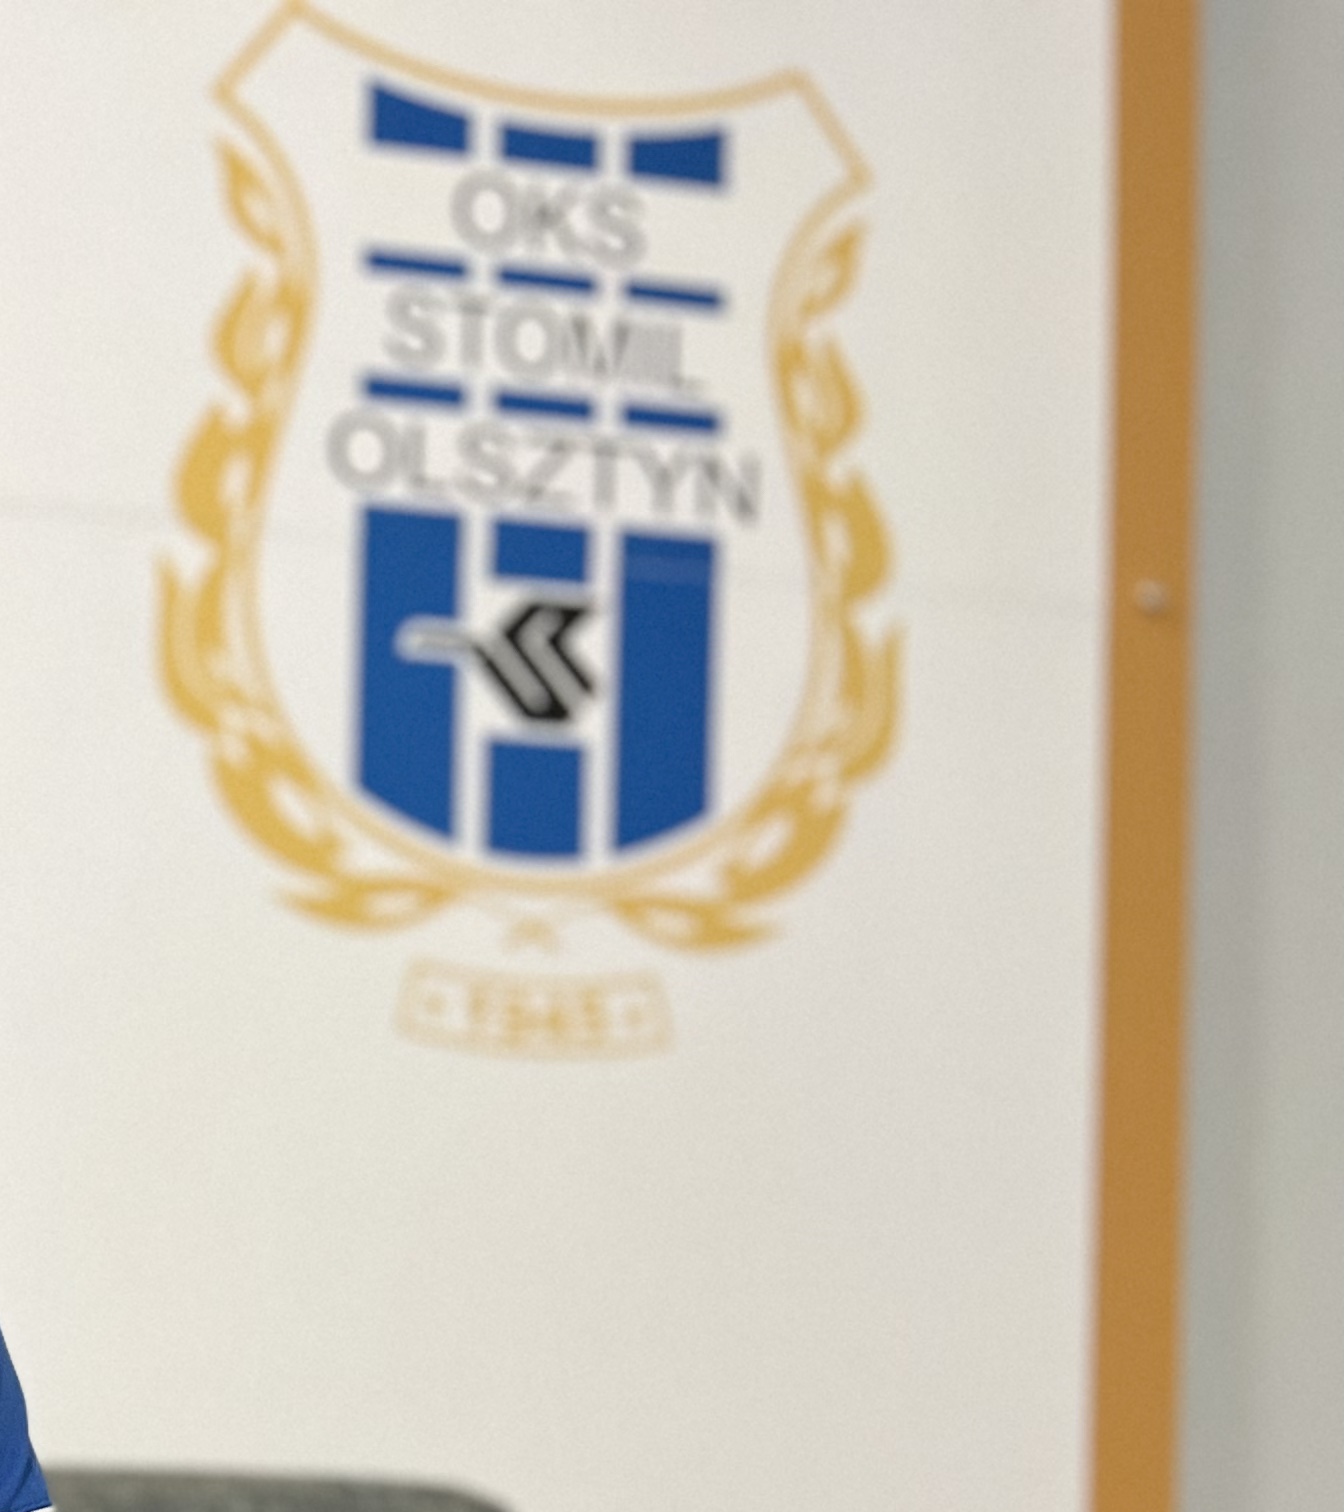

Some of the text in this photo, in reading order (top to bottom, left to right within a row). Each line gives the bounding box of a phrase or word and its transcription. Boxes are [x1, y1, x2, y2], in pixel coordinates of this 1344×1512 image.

[450, 168, 649, 270] OKS
[382, 283, 704, 391] STOMIL
[324, 408, 762, 526] OLSZTYN
